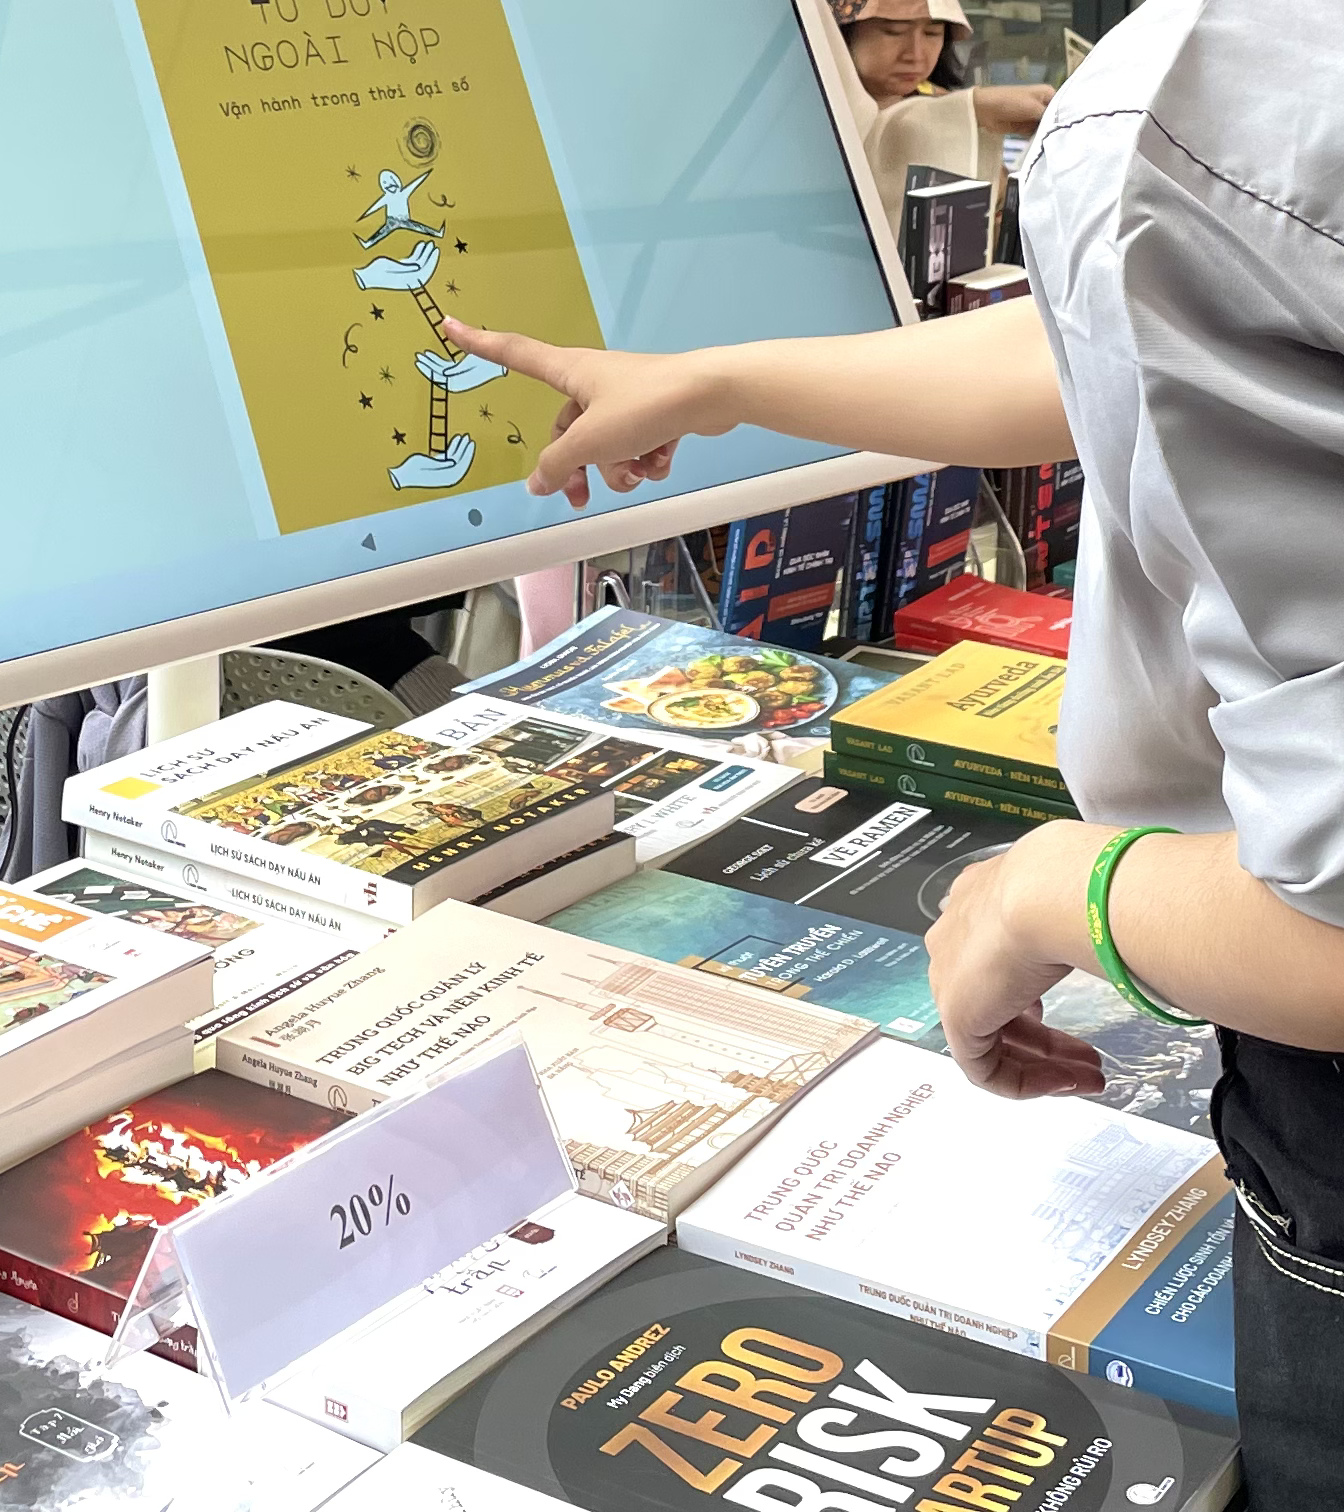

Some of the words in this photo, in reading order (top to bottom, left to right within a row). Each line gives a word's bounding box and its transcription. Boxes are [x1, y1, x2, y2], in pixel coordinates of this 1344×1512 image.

[224, 31, 348, 73] NGOÀI
[220, 101, 252, 119] Vận
[312, 91, 360, 107] trong
[369, 86, 405, 100] thời
[946, 660, 1040, 711] Ayurveda
[89, 804, 111, 820] Henry
[113, 812, 143, 828] Notaker
[412, 834, 486, 871] HENRY
[493, 788, 590, 833] NOTAKER
[850, 806, 919, 848] RAMEN
[244, 850, 267, 868] SÁCH
[265, 1006, 308, 1038] Angela
[344, 966, 386, 991] Zhang
[315, 1028, 379, 1066] TRUNG
[375, 1000, 424, 1031] QUỐC
[420, 973, 466, 1003] QUẢN
[463, 960, 487, 984] LÝ
[345, 1054, 380, 1076] BIG
[376, 1027, 426, 1057] TECH
[420, 1013, 447, 1031] VÀ
[442, 989, 485, 1016] NỀN
[477, 968, 525, 994] KINH
[519, 951, 545, 972] TẾ
[377, 1058, 421, 1087] NHƯ
[417, 1035, 458, 1062] THẾ
[838, 1122, 892, 1169] DOANH
[330, 1174, 410, 1249] 20%
[744, 1177, 800, 1221] TRUNG
[1121, 1219, 1176, 1270] LYNDSEY
[1165, 1187, 1208, 1222] ZHANG
[1145, 1286, 1179, 1315] CHIẾN
[1189, 1243, 1216, 1265] SINH
[1171, 1301, 1197, 1323] CHO
[1192, 1284, 1212, 1304] CÁC
[560, 1369, 615, 1410] PAULO
[609, 1323, 671, 1372] ANDREZ
[664, 1345, 686, 1362] dịch
[599, 1326, 844, 1495] ZERO
[722, 1358, 997, 1512] RISK
[1090, 1437, 1113, 1459] RO
